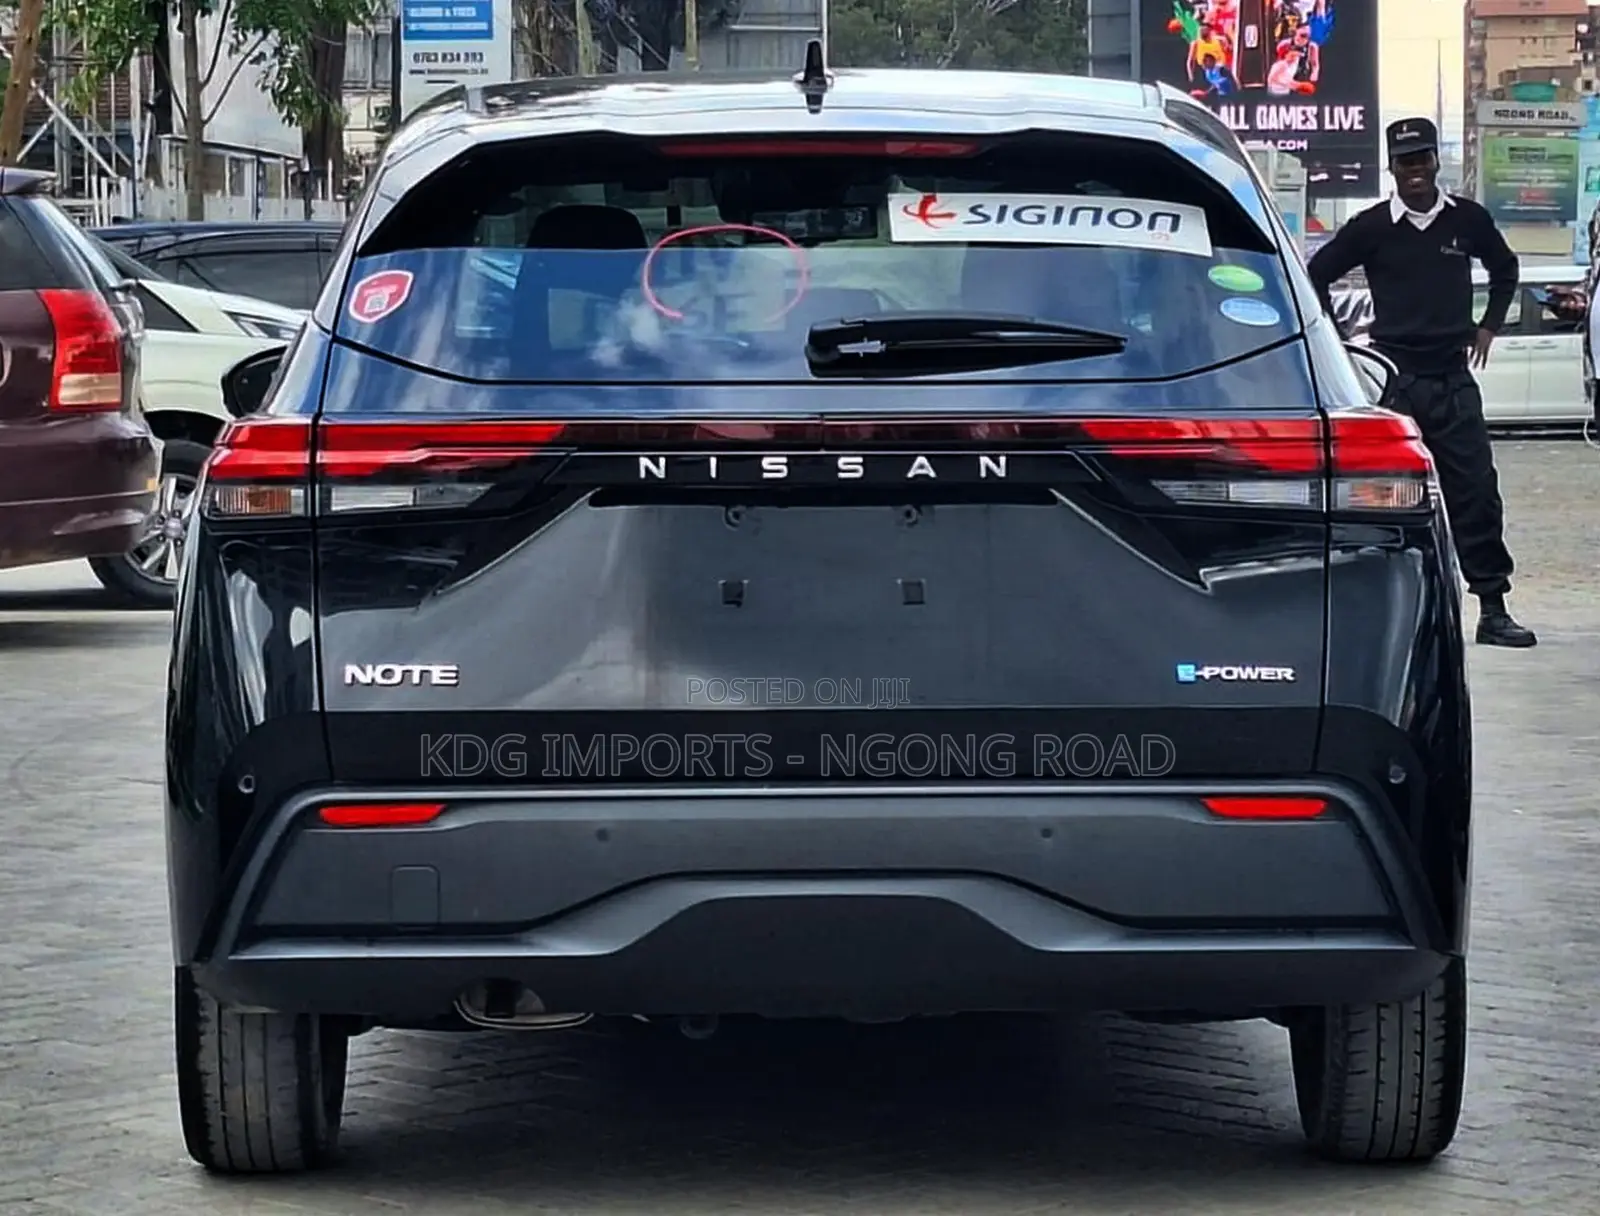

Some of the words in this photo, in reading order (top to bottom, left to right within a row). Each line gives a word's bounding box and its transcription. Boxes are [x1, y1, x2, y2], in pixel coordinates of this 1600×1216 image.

[1256, 105, 1318, 131] GAMES
[1324, 105, 1365, 130] LIVE
[638, 455, 1008, 479] NISSAN
[344, 663, 460, 687] NOTE
